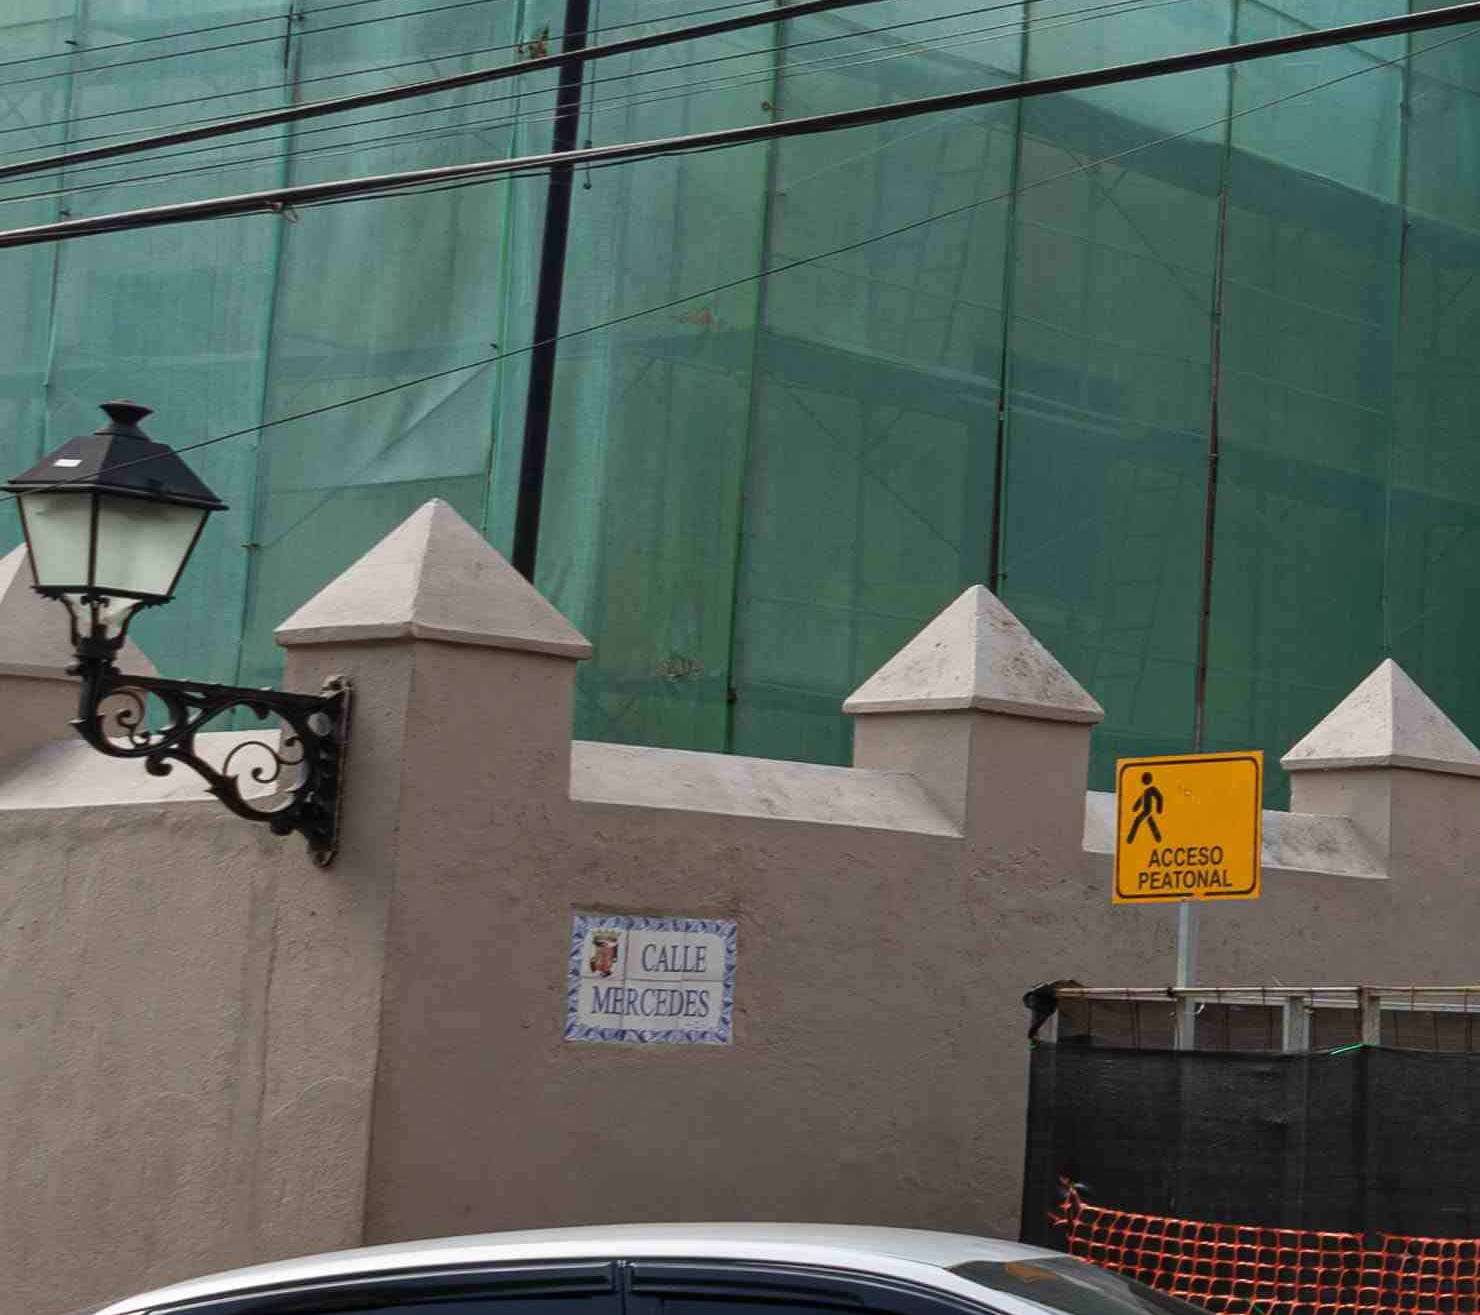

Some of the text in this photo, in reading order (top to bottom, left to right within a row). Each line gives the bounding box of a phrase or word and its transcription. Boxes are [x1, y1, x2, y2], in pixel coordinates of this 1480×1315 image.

[1148, 845, 1225, 868] ACCESO
[1138, 869, 1232, 890] PEATONAL
[641, 943, 708, 974] CALLE
[591, 986, 711, 1018] MERCEDES
